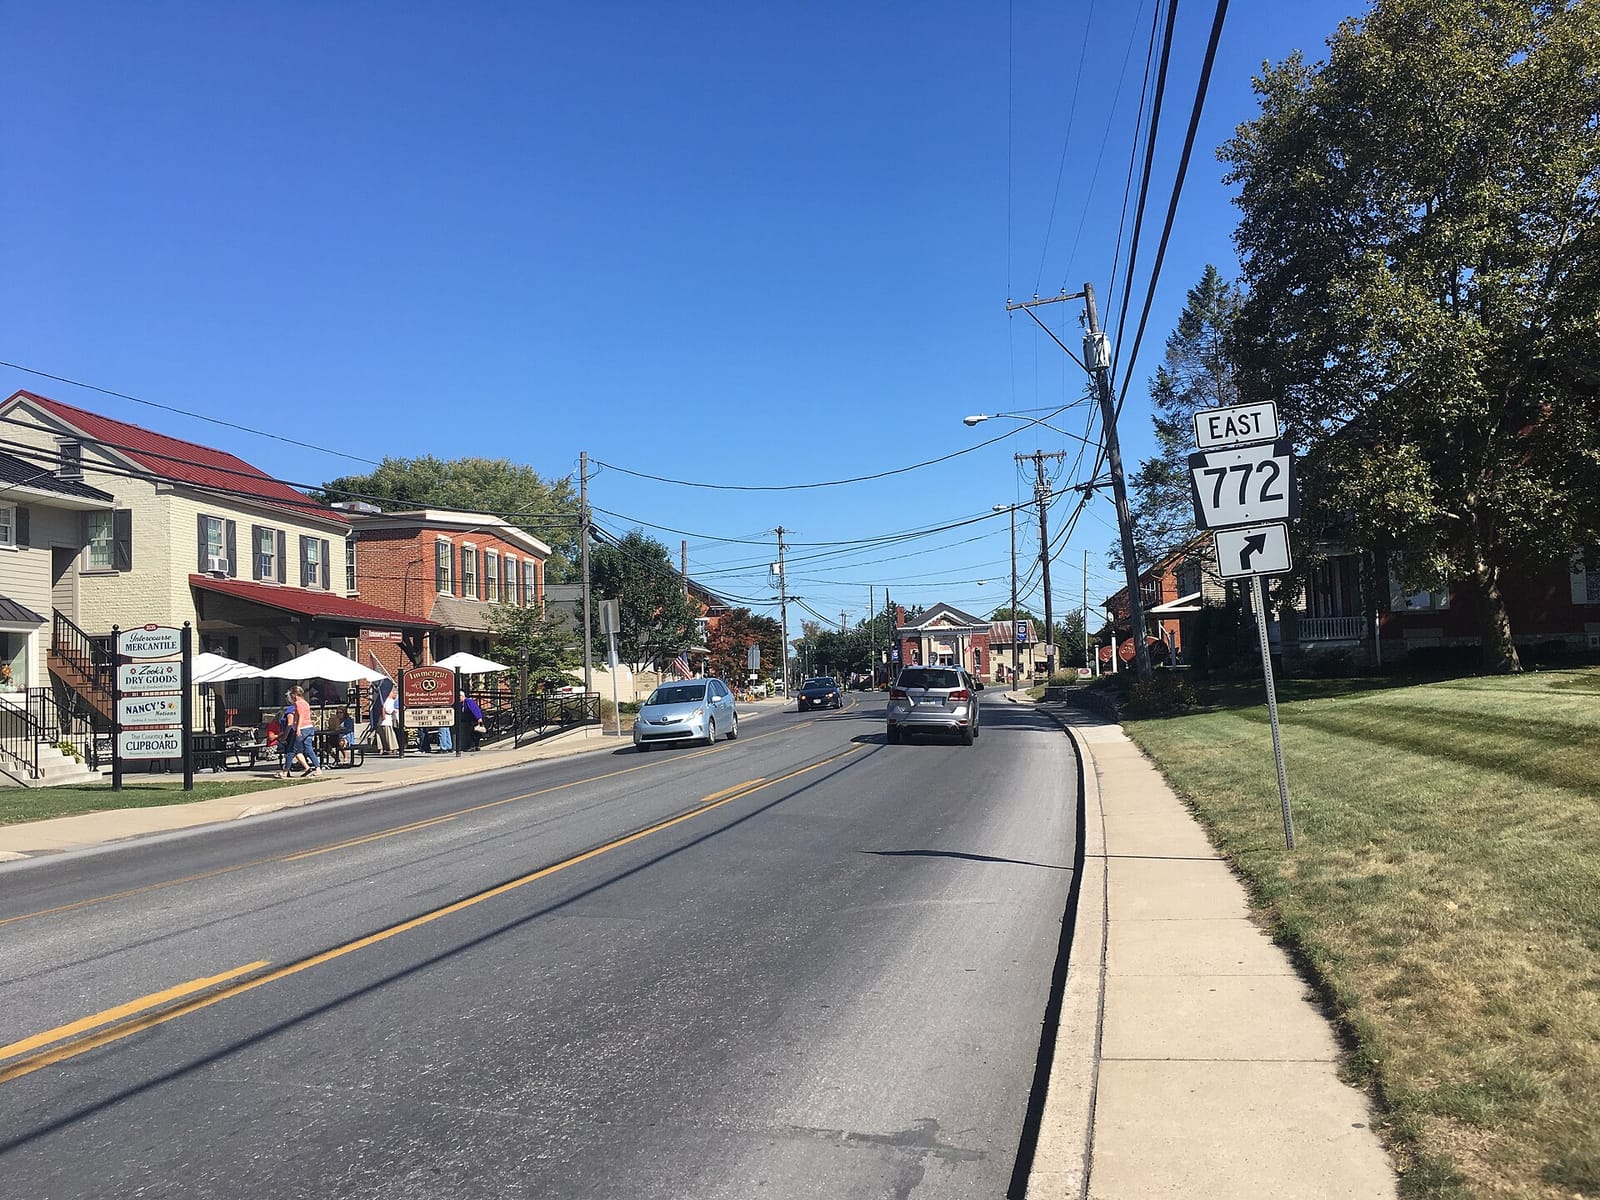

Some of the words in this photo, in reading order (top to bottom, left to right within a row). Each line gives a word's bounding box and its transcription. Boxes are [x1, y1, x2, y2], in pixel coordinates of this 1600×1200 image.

[1208, 412, 1262, 440] EAST
[1203, 459, 1284, 508] 772
[129, 632, 172, 643] Intercourse
[125, 641, 177, 652] MERCANTILE
[139, 665, 164, 675] Zook's
[410, 671, 448, 679] Immergut
[125, 676, 144, 685] DRY
[145, 674, 178, 684] GOODS
[125, 701, 166, 715] NANCY'S
[125, 740, 178, 751] CUPBOARD
